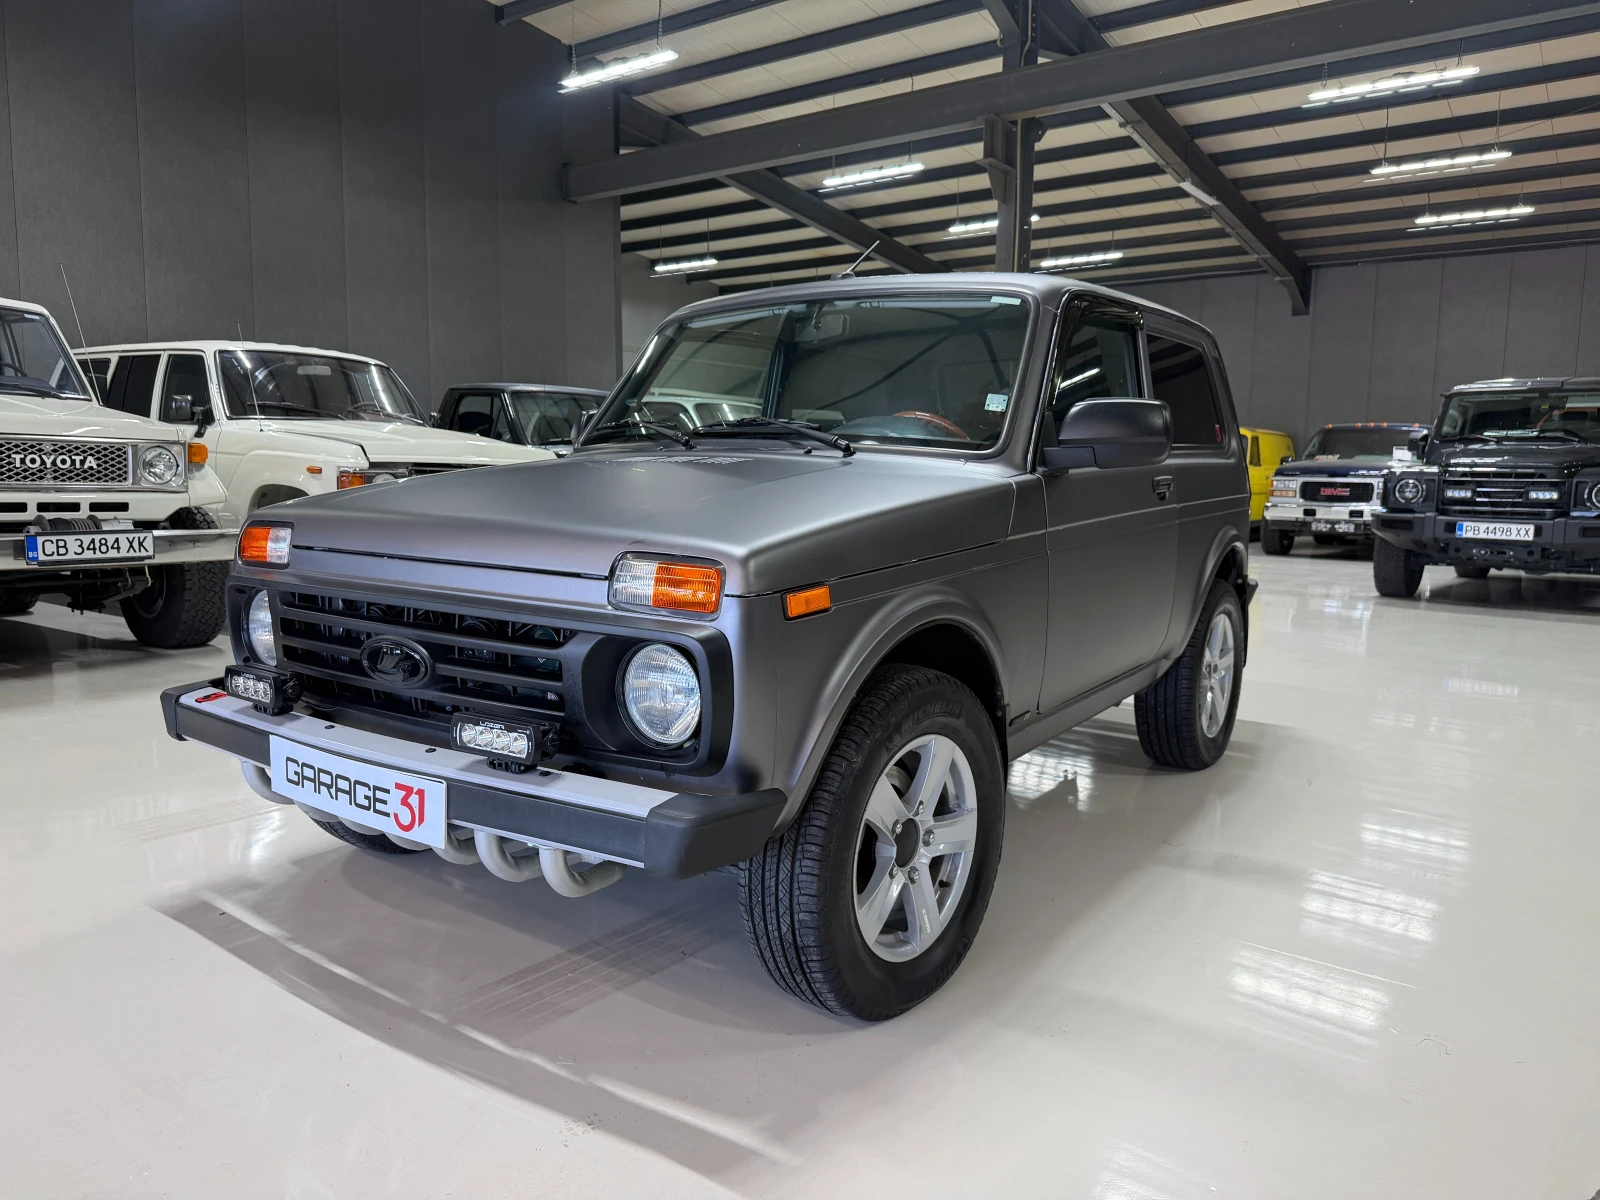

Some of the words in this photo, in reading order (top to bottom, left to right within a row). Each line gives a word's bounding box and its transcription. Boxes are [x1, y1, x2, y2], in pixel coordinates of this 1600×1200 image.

[11, 453, 98, 469] TOYOTA
[1464, 525, 1480, 536] PB
[1483, 525, 1512, 537] 4498
[1514, 527, 1531, 538] XX
[41, 538, 69, 557] CB
[73, 537, 121, 556] 3484
[125, 535, 149, 554] XK
